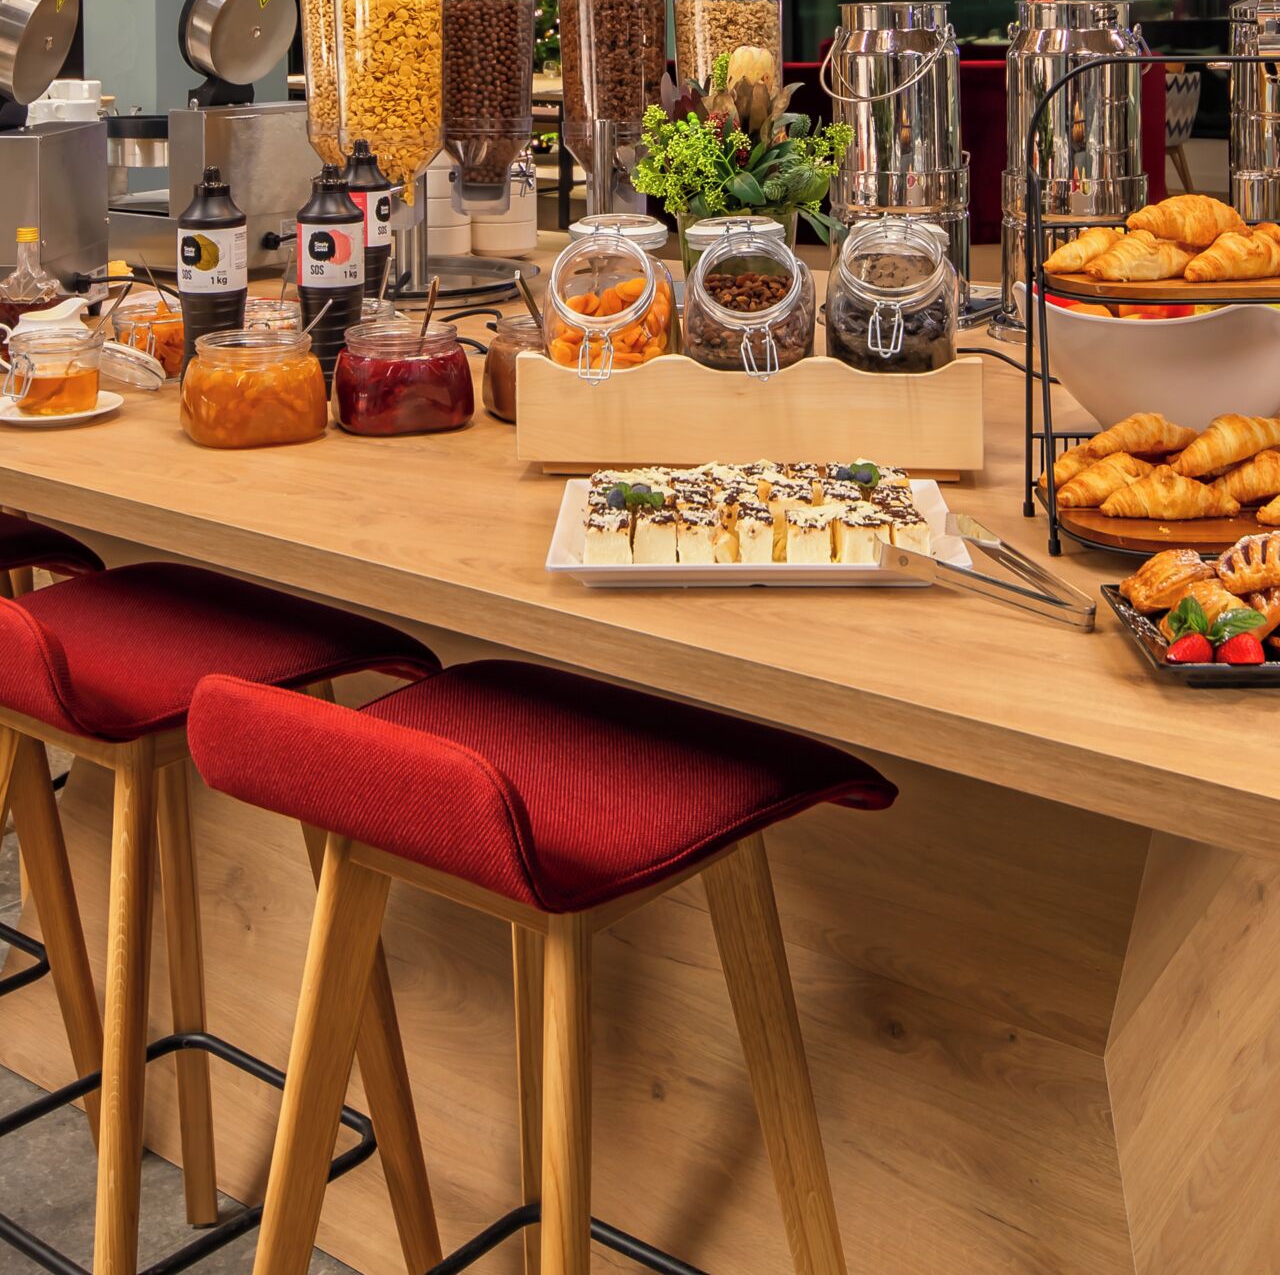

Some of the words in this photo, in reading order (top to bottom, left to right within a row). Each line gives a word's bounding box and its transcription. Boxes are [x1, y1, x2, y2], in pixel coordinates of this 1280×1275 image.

[182, 269, 192, 280] SOS
[310, 265, 325, 275] SOS
[349, 270, 357, 279] kg
[210, 276, 215, 284] 1
[217, 276, 228, 285] kg
